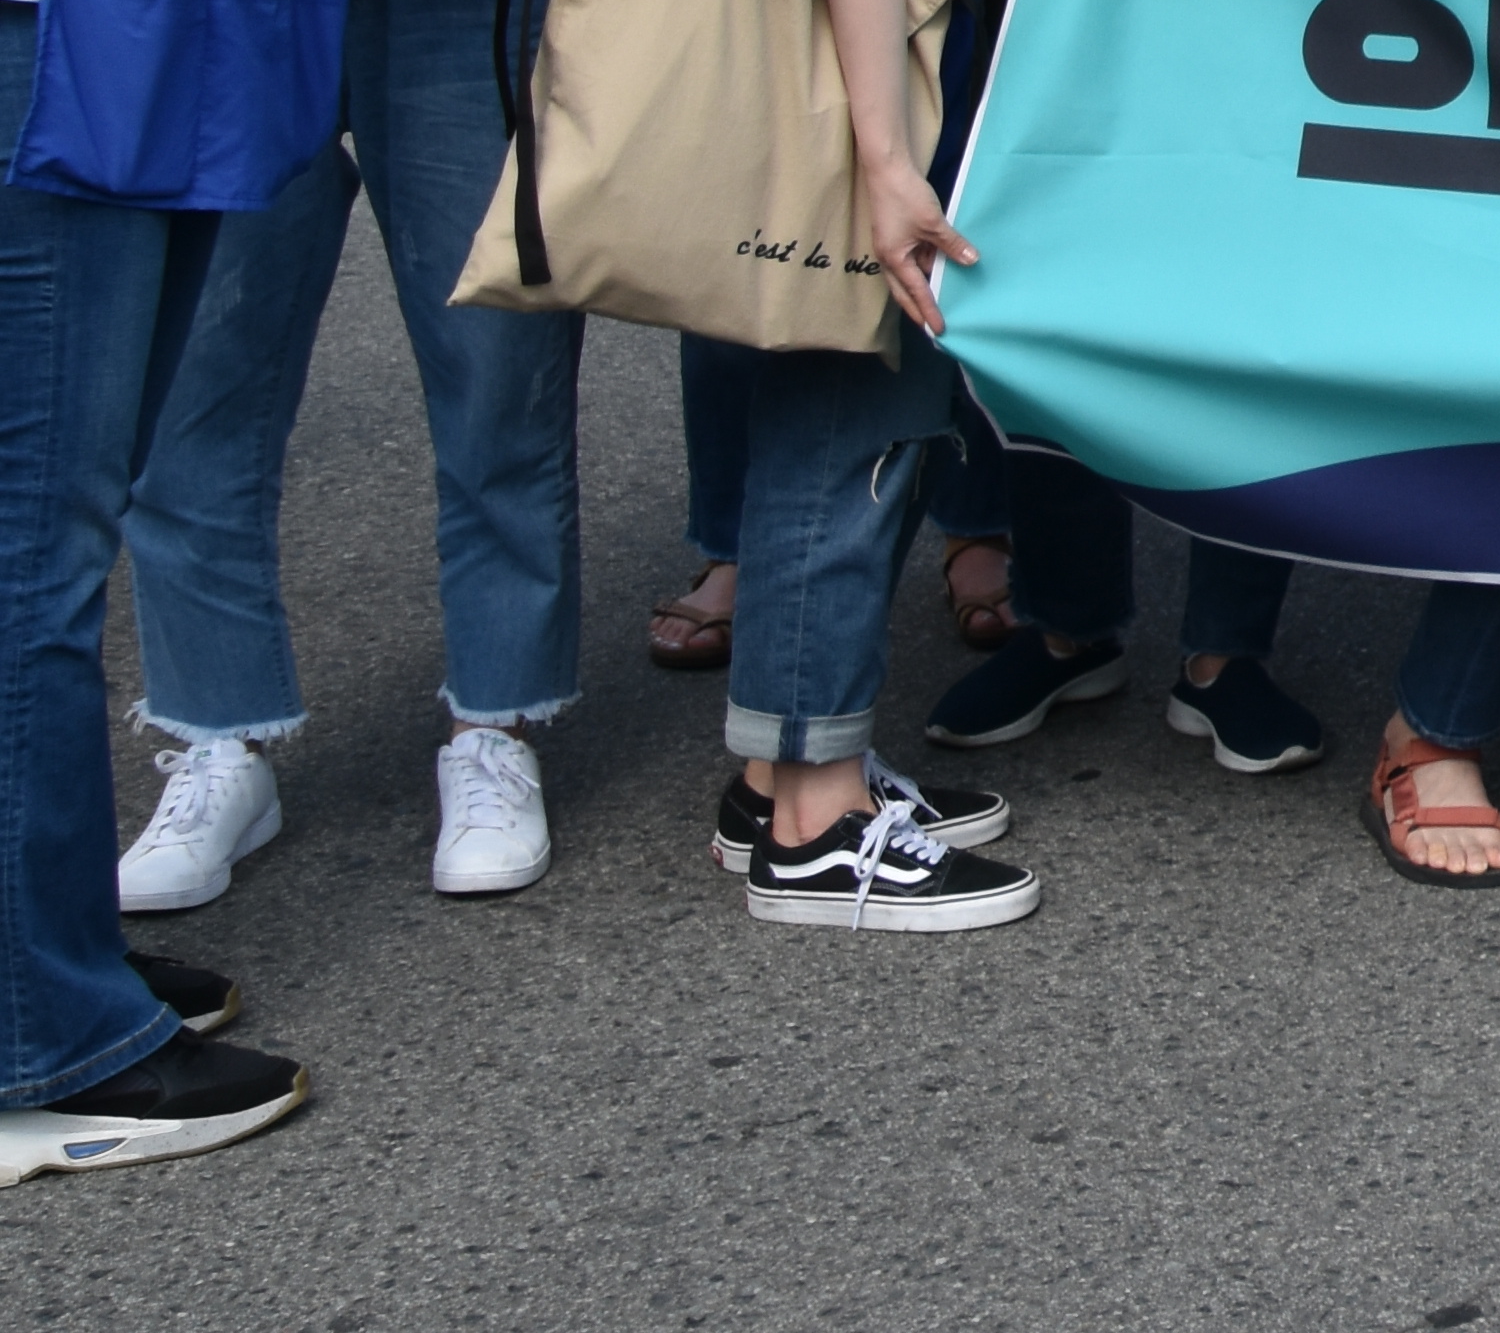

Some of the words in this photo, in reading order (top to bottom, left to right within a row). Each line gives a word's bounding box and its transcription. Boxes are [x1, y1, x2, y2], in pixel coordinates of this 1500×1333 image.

[737, 228, 798, 263] c'est
[804, 241, 832, 270] la
[844, 254, 882, 276] vie
